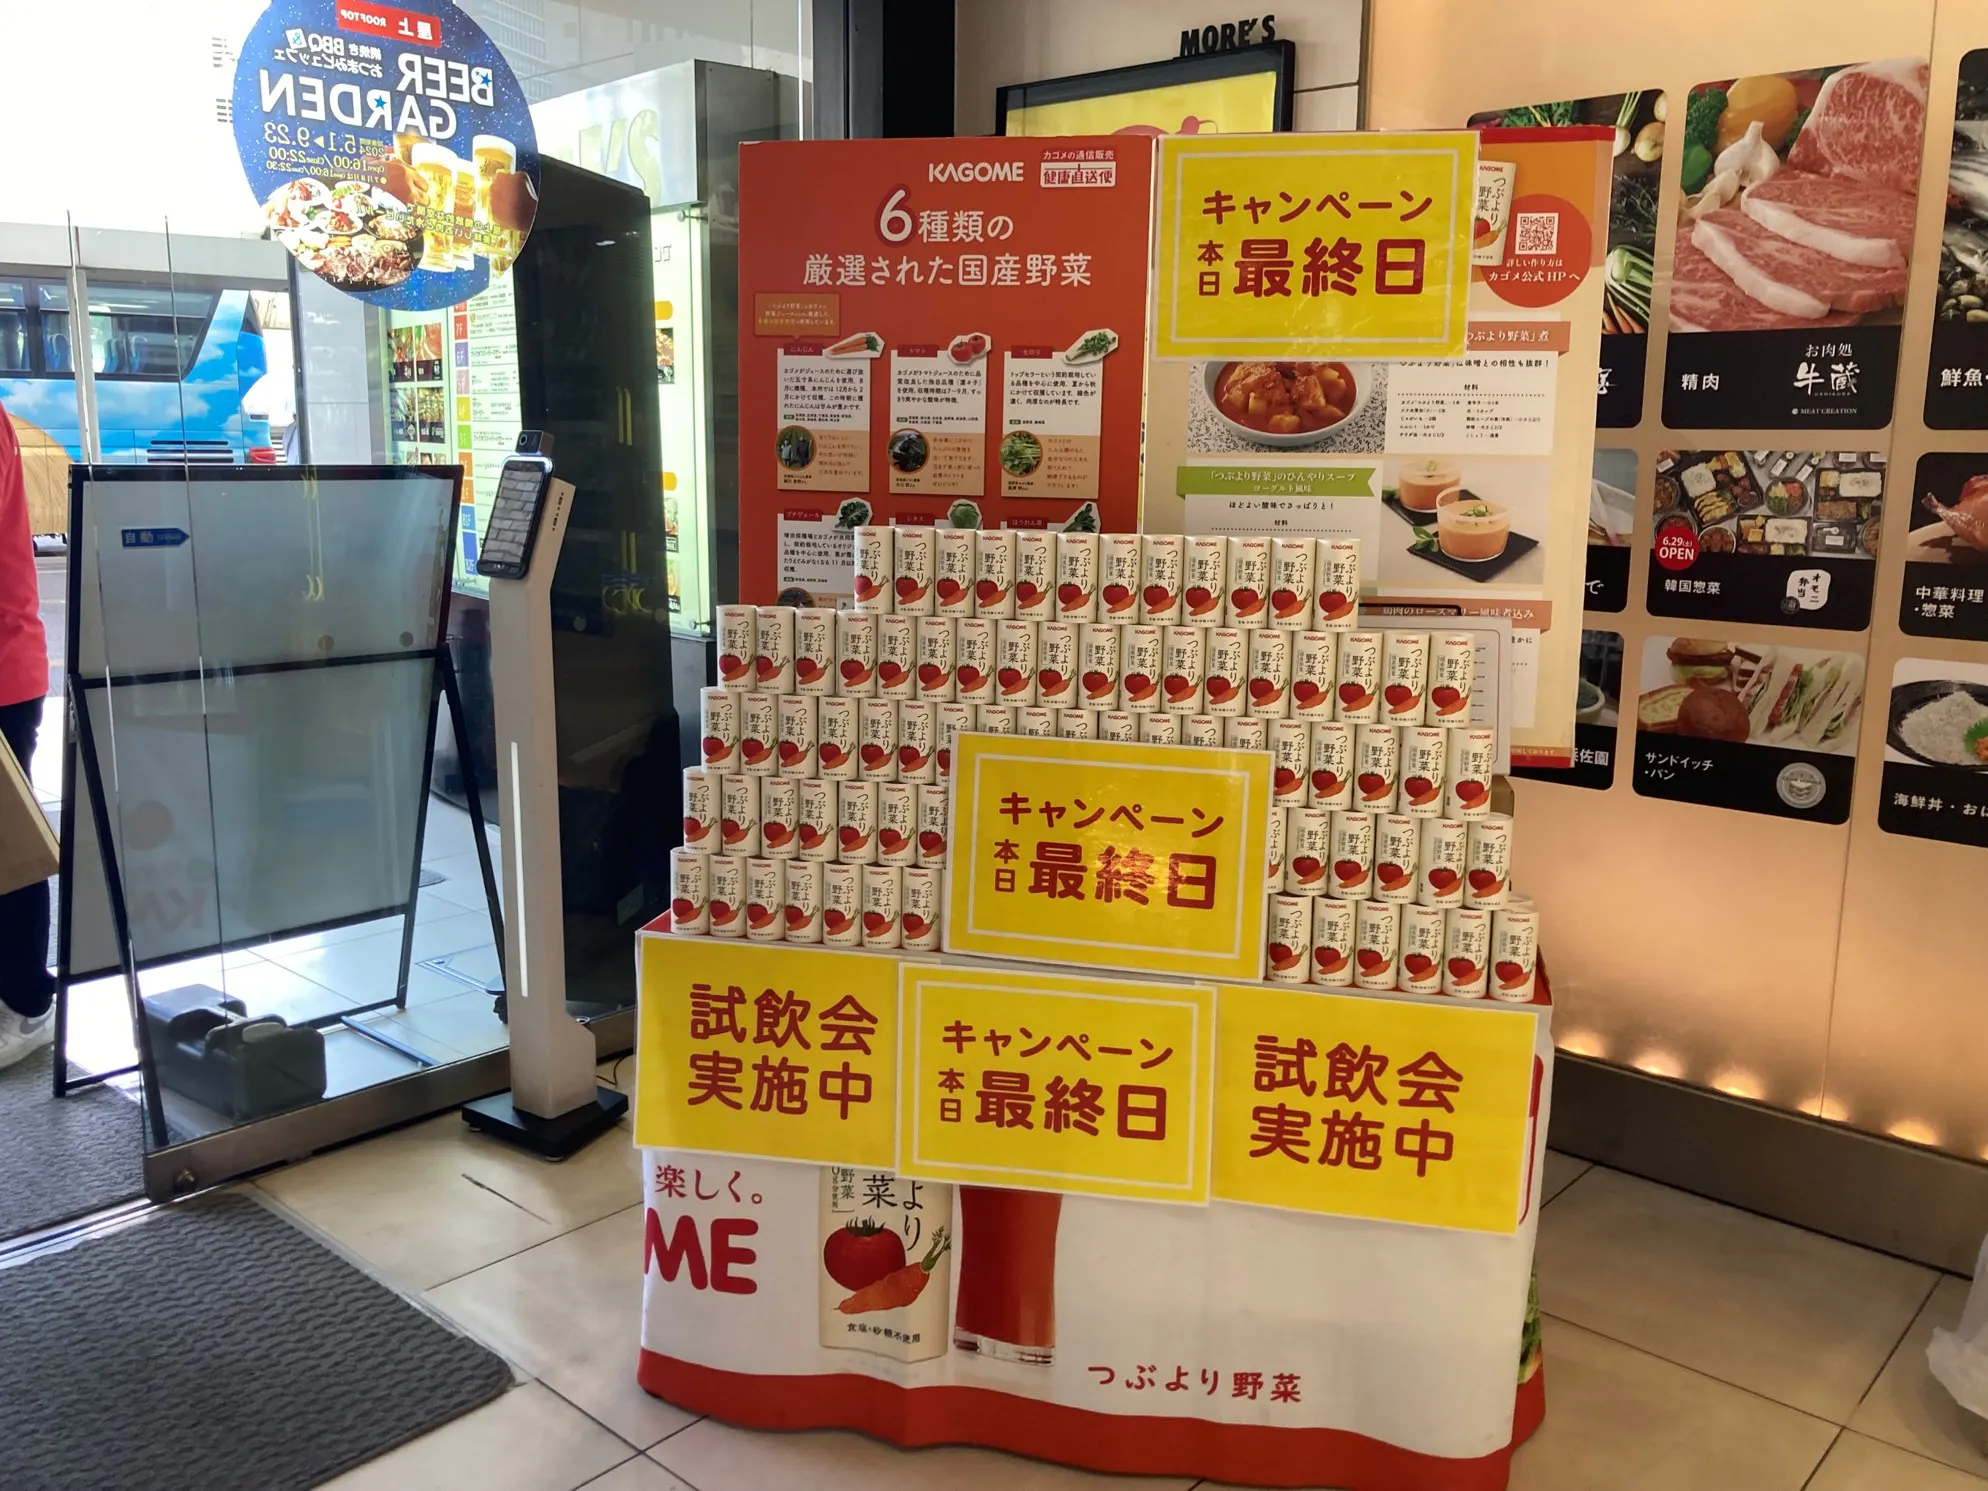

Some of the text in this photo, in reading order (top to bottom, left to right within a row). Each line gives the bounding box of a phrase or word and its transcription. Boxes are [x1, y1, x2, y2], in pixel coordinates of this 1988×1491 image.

[1180, 15, 1276, 57] MORE'S
[929, 162, 1024, 183] KAGOME
[1043, 150, 1114, 160] カゴメの通信販売
[1043, 165, 1113, 185] 健康直送便
[878, 188, 1014, 244] 6種類の
[1202, 190, 1433, 226] キャンペーン
[1478, 186, 1492, 212] 野菜
[1490, 177, 1506, 226] つぶより
[803, 252, 1093, 287] 厳選された国産野菜
[1233, 236, 1426, 299] 最終日
[1506, 258, 1563, 267] 詳しい作り方は
[1022, 348, 1041, 356] セロリ
[1805, 342, 1853, 358] お肉処
[1681, 372, 1720, 391] 精肉
[1793, 361, 1861, 396] 牛蔵
[1210, 470, 1357, 483] 「つぶより野菜」のひんやりスープ
[904, 549, 915, 572] 野菜
[915, 542, 927, 583] つぶより
[984, 552, 996, 575] 野菜
[995, 545, 1007, 586] つぶより
[1115, 556, 1127, 579] 野菜
[1126, 549, 1138, 591] つぶより
[1197, 559, 1209, 582] 野菜
[1659, 546, 1694, 560] OPEN
[1209, 551, 1221, 594] つぶより
[1333, 563, 1345, 586] 野菜
[1345, 554, 1357, 597] つぶより
[1664, 578, 1721, 595] 韓国惣菜
[1915, 585, 1984, 604] 中華料理
[727, 628, 738, 651] 野菜
[738, 620, 750, 660] つぶより
[1260, 651, 1272, 674] 野菜
[1272, 643, 1284, 684] つぶより
[1398, 657, 1411, 680] 野菜
[1410, 648, 1423, 692] つぶより
[827, 717, 839, 739] 野菜
[838, 709, 850, 749] つぶより
[1419, 749, 1431, 772] 野菜
[1431, 740, 1443, 784] つぶより
[1645, 751, 1714, 771] サンドイッチ
[999, 792, 1224, 838] キャンペーン
[680, 873, 691, 894] 野菜
[690, 865, 702, 904] つぶより
[1028, 841, 1217, 911] 最終日
[1278, 917, 1290, 940] 野菜
[1290, 910, 1303, 951] つぶより
[1509, 934, 1522, 957] 野菜
[1521, 926, 1534, 968] つぶより
[689, 983, 879, 1056] 試飲会
[942, 1020, 1174, 1071] キャンペーン
[687, 1050, 873, 1121] 実施中
[1254, 1034, 1464, 1115] 試飲会
[974, 1069, 1168, 1141] 最終日
[1249, 1104, 1454, 1179] 実施中
[655, 1164, 763, 1205] 楽しく。
[644, 1207, 759, 1294] ME
[847, 1321, 921, 1344] 食塩・砂糖不使用
[1088, 1363, 1303, 1403] つぶより野菜
